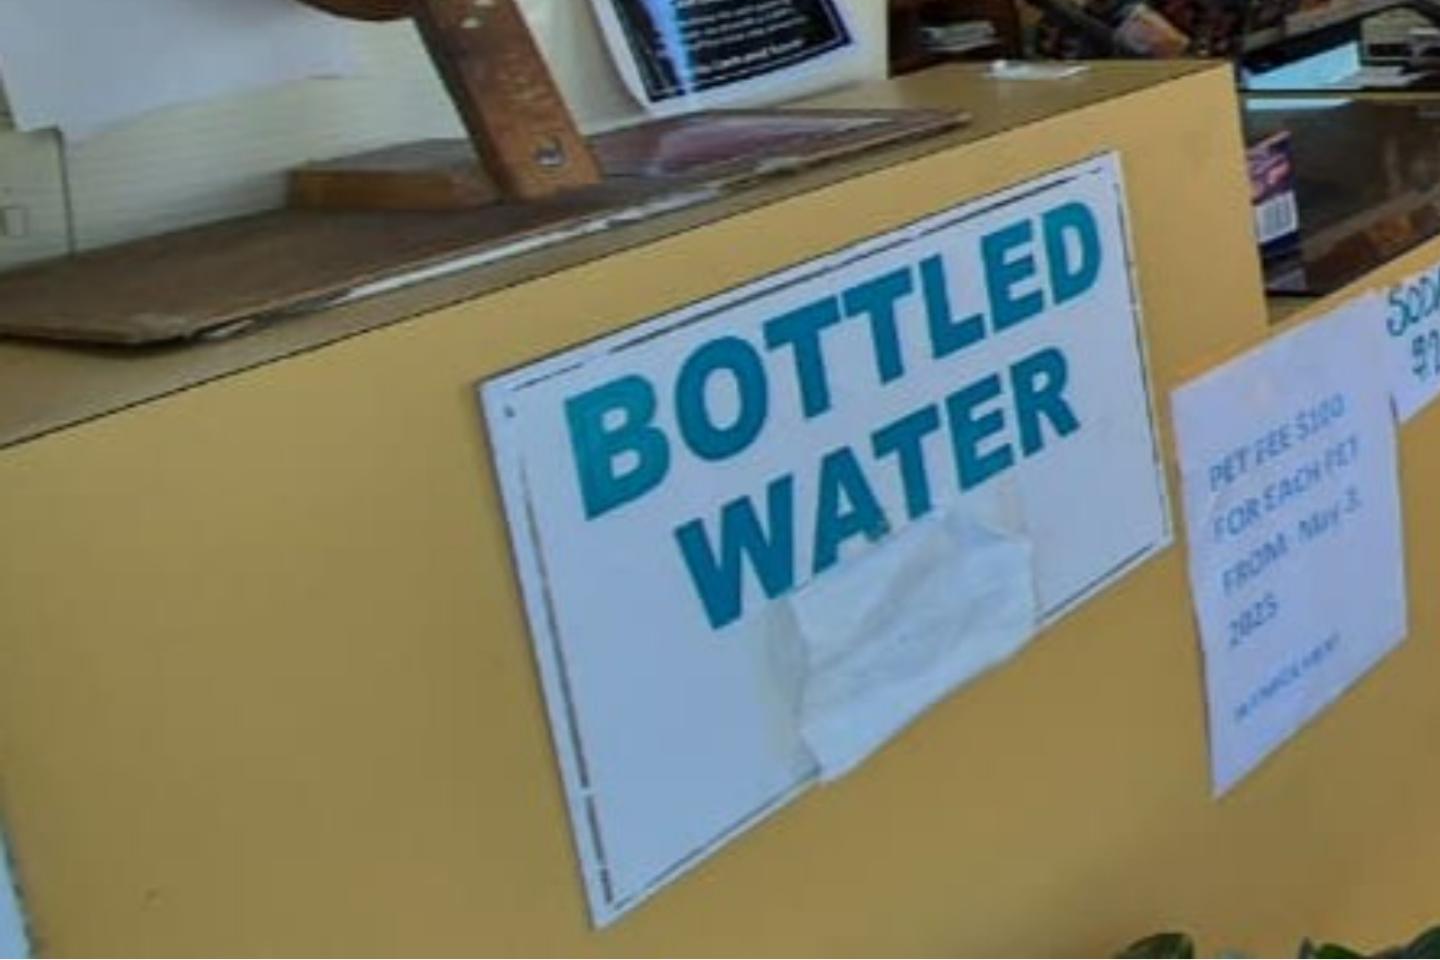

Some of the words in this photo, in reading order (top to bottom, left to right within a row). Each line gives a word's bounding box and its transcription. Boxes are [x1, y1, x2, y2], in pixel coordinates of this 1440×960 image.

[563, 200, 1104, 522] BOTTLED
[672, 344, 1081, 631] WATER
[1209, 446, 1249, 493] PET
[1254, 422, 1291, 467] FEE
[1213, 496, 1261, 543] FOR
[1262, 459, 1323, 514] EACH
